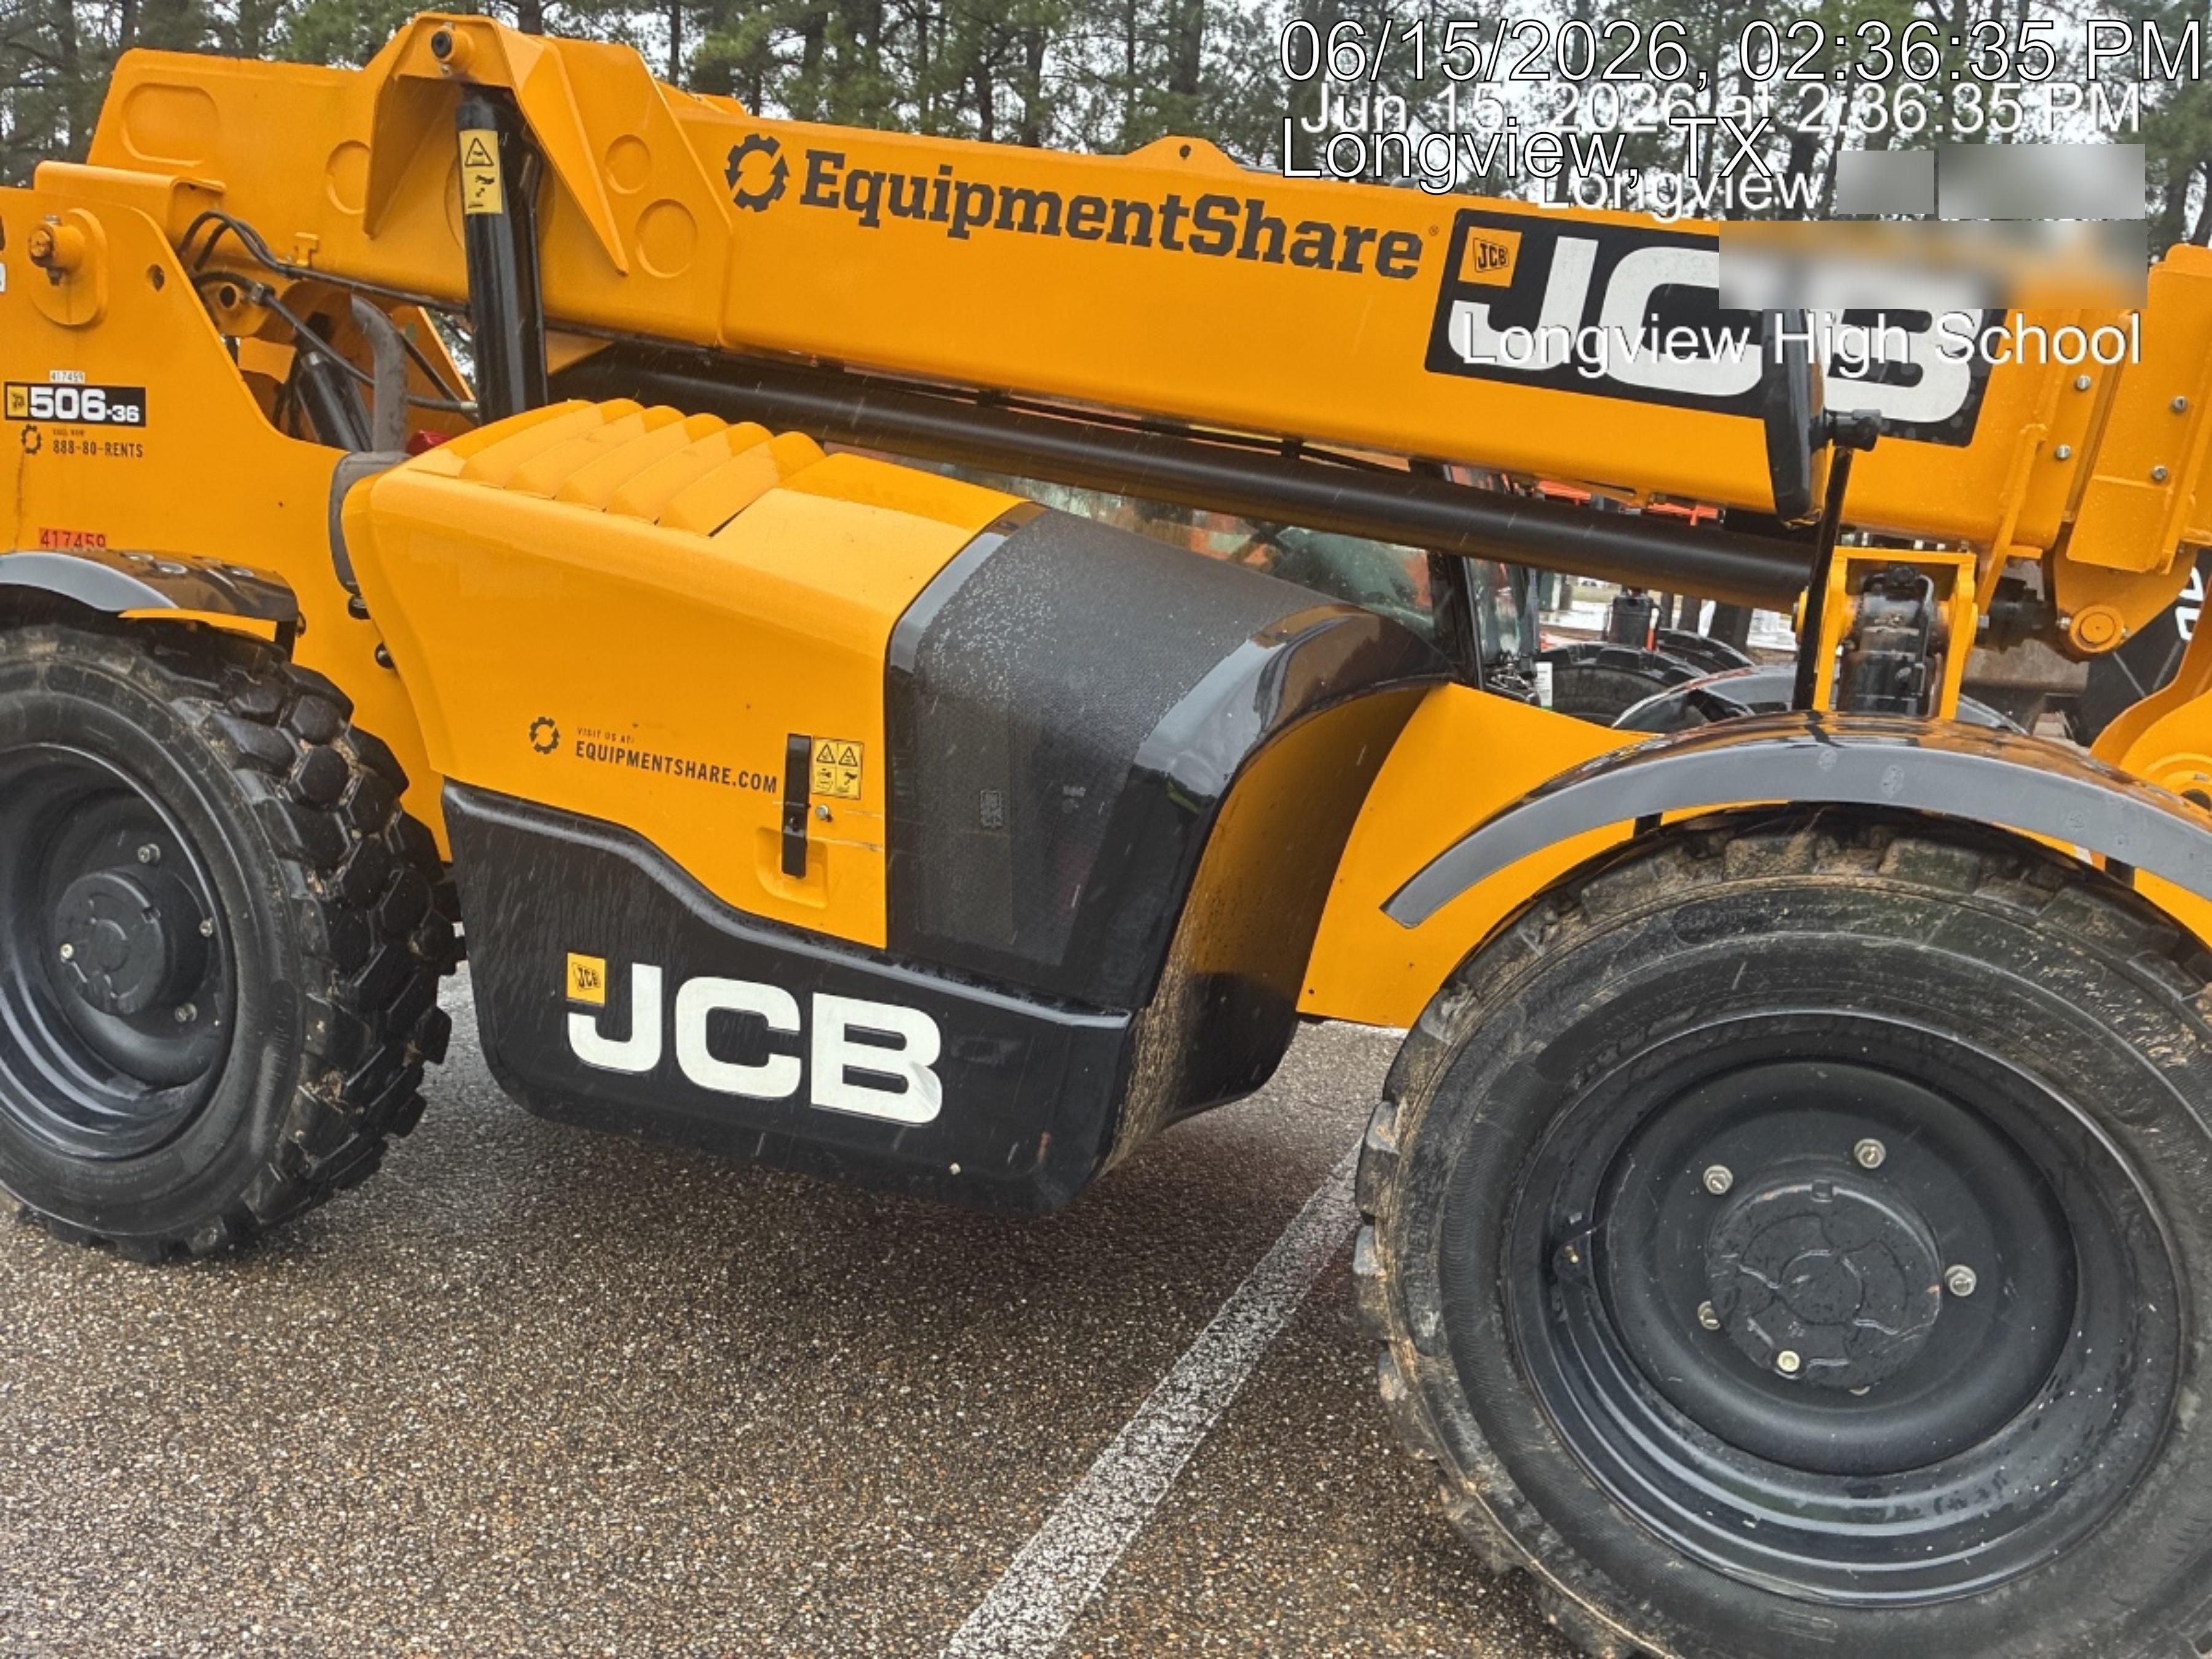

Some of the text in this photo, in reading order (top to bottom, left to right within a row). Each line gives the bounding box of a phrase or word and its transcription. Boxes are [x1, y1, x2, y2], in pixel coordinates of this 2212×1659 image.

[799, 149, 1424, 280] EquipmentShare
[1478, 242, 1507, 269] JCB
[53, 440, 143, 458] 888-80-RENTS
[576, 740, 778, 794] EQUIPMENTSHARE.COM
[567, 962, 943, 1124] JCB
